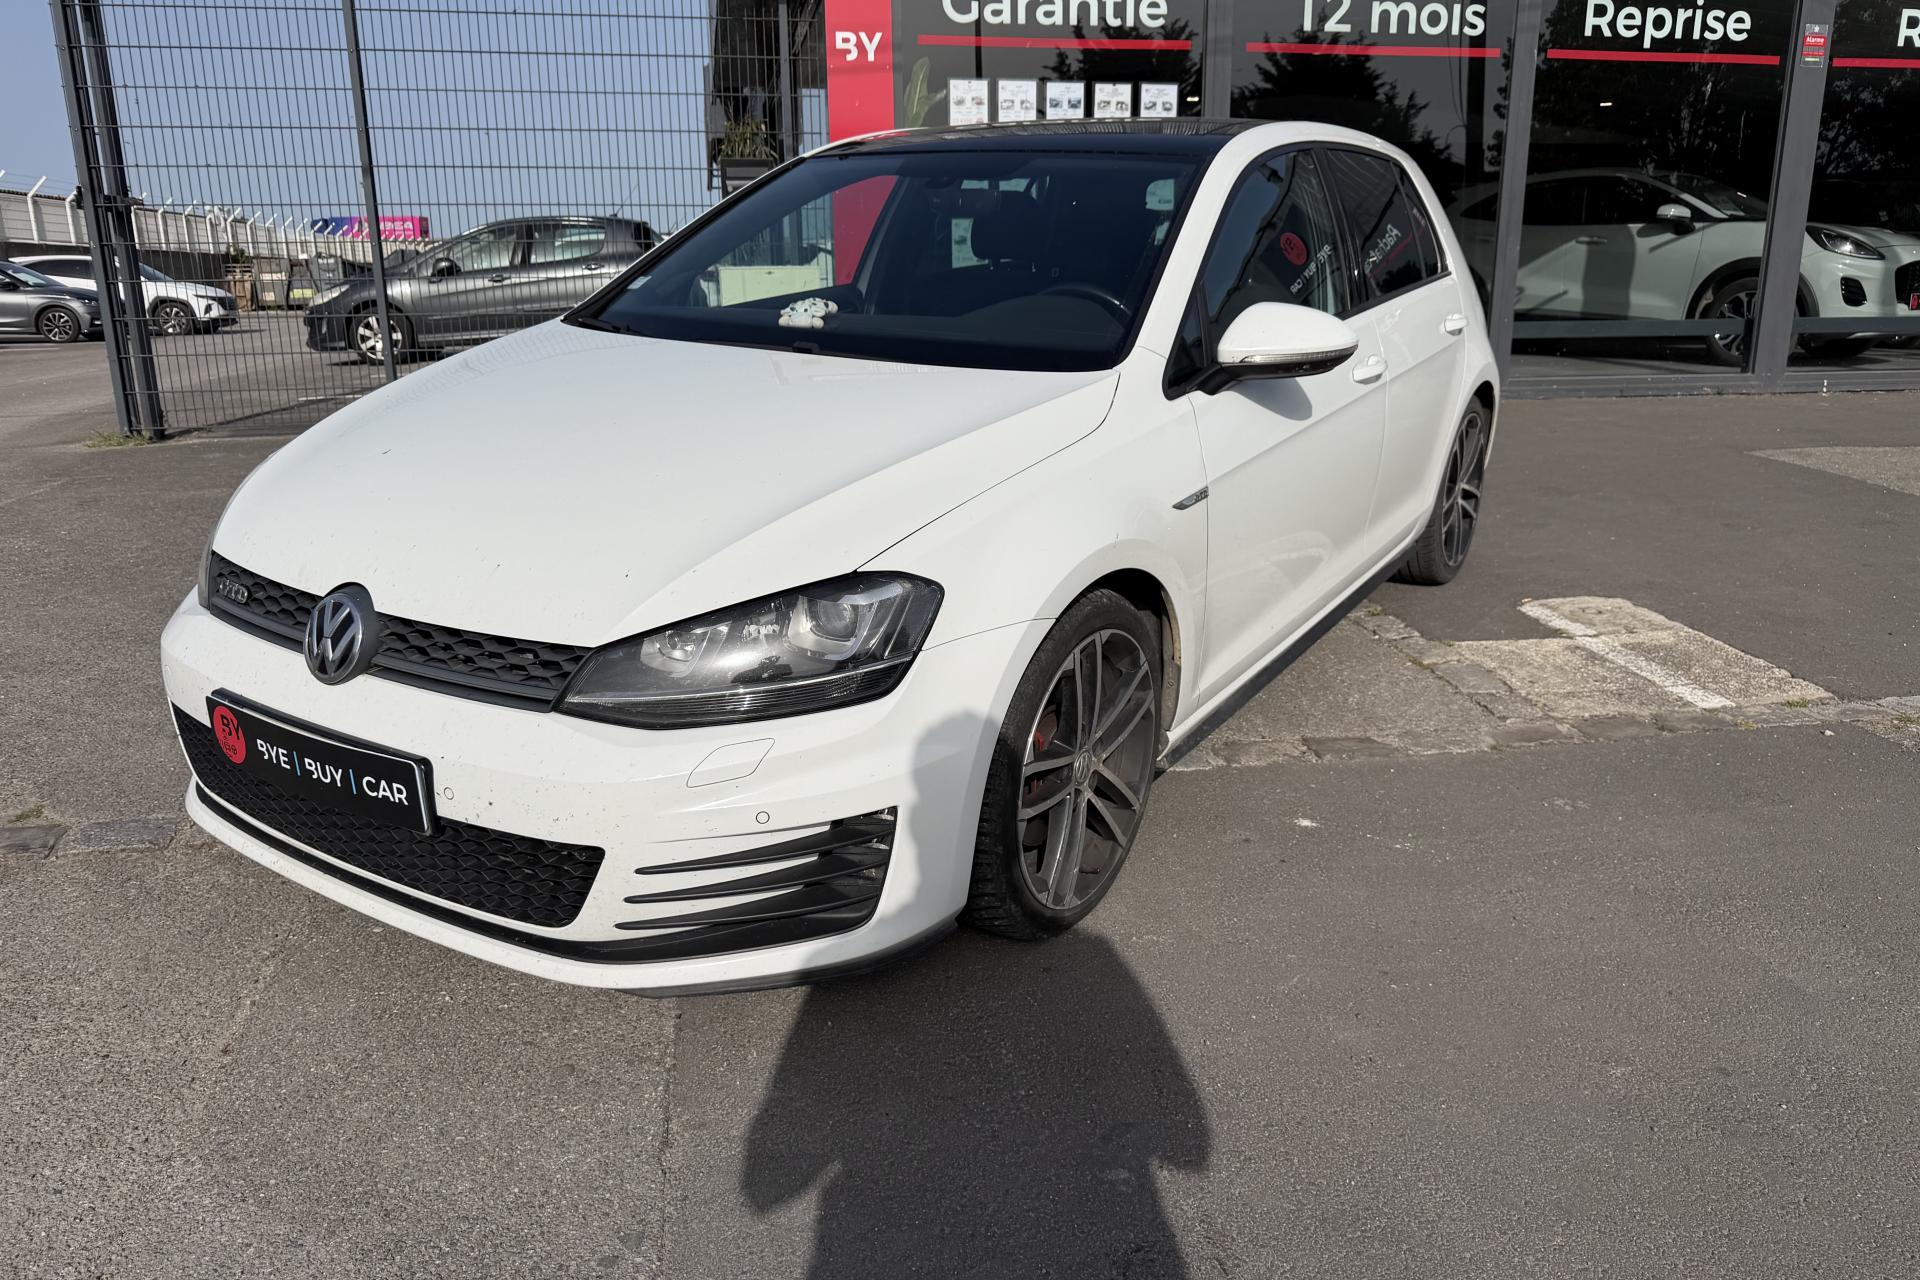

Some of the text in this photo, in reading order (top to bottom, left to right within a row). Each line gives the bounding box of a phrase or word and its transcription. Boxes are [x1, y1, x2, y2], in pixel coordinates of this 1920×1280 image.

[942, 0, 1168, 28] Garantie
[1303, 0, 1486, 36] 12 mois
[1584, 0, 1752, 49] Reprise
[835, 31, 883, 62] BY
[256, 738, 291, 770] BYE
[304, 757, 343, 788] BUY
[362, 776, 409, 806] CAR
